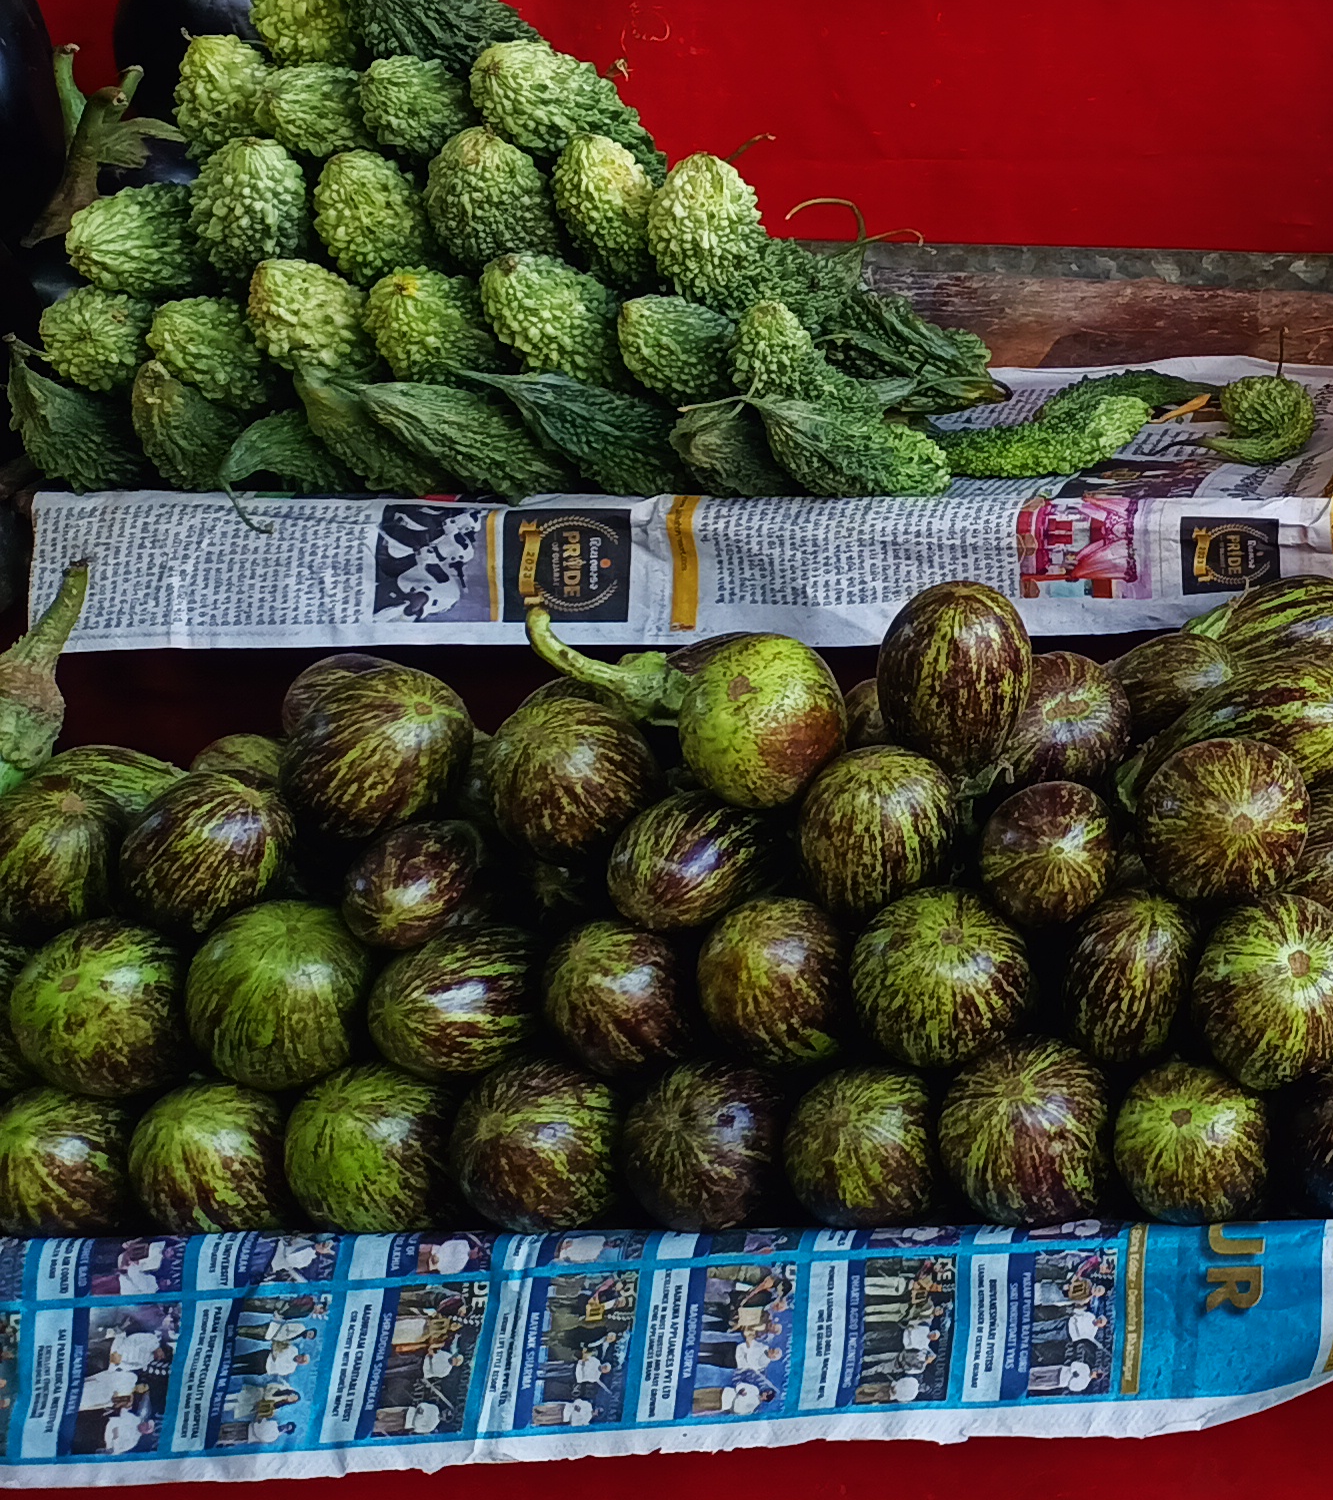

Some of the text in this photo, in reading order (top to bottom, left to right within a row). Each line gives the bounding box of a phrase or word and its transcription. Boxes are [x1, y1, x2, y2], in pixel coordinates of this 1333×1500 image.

[523, 551, 535, 579] 2023
[209, 1306, 223, 1333] PARAM
[521, 1312, 540, 1389] MAYANK SHARMA
[665, 1322, 680, 1367] APPLIANCES
[682, 1349, 693, 1378] SURYA
[190, 1403, 203, 1439] HOSPITAL
[341, 1399, 355, 1421] TRUST
